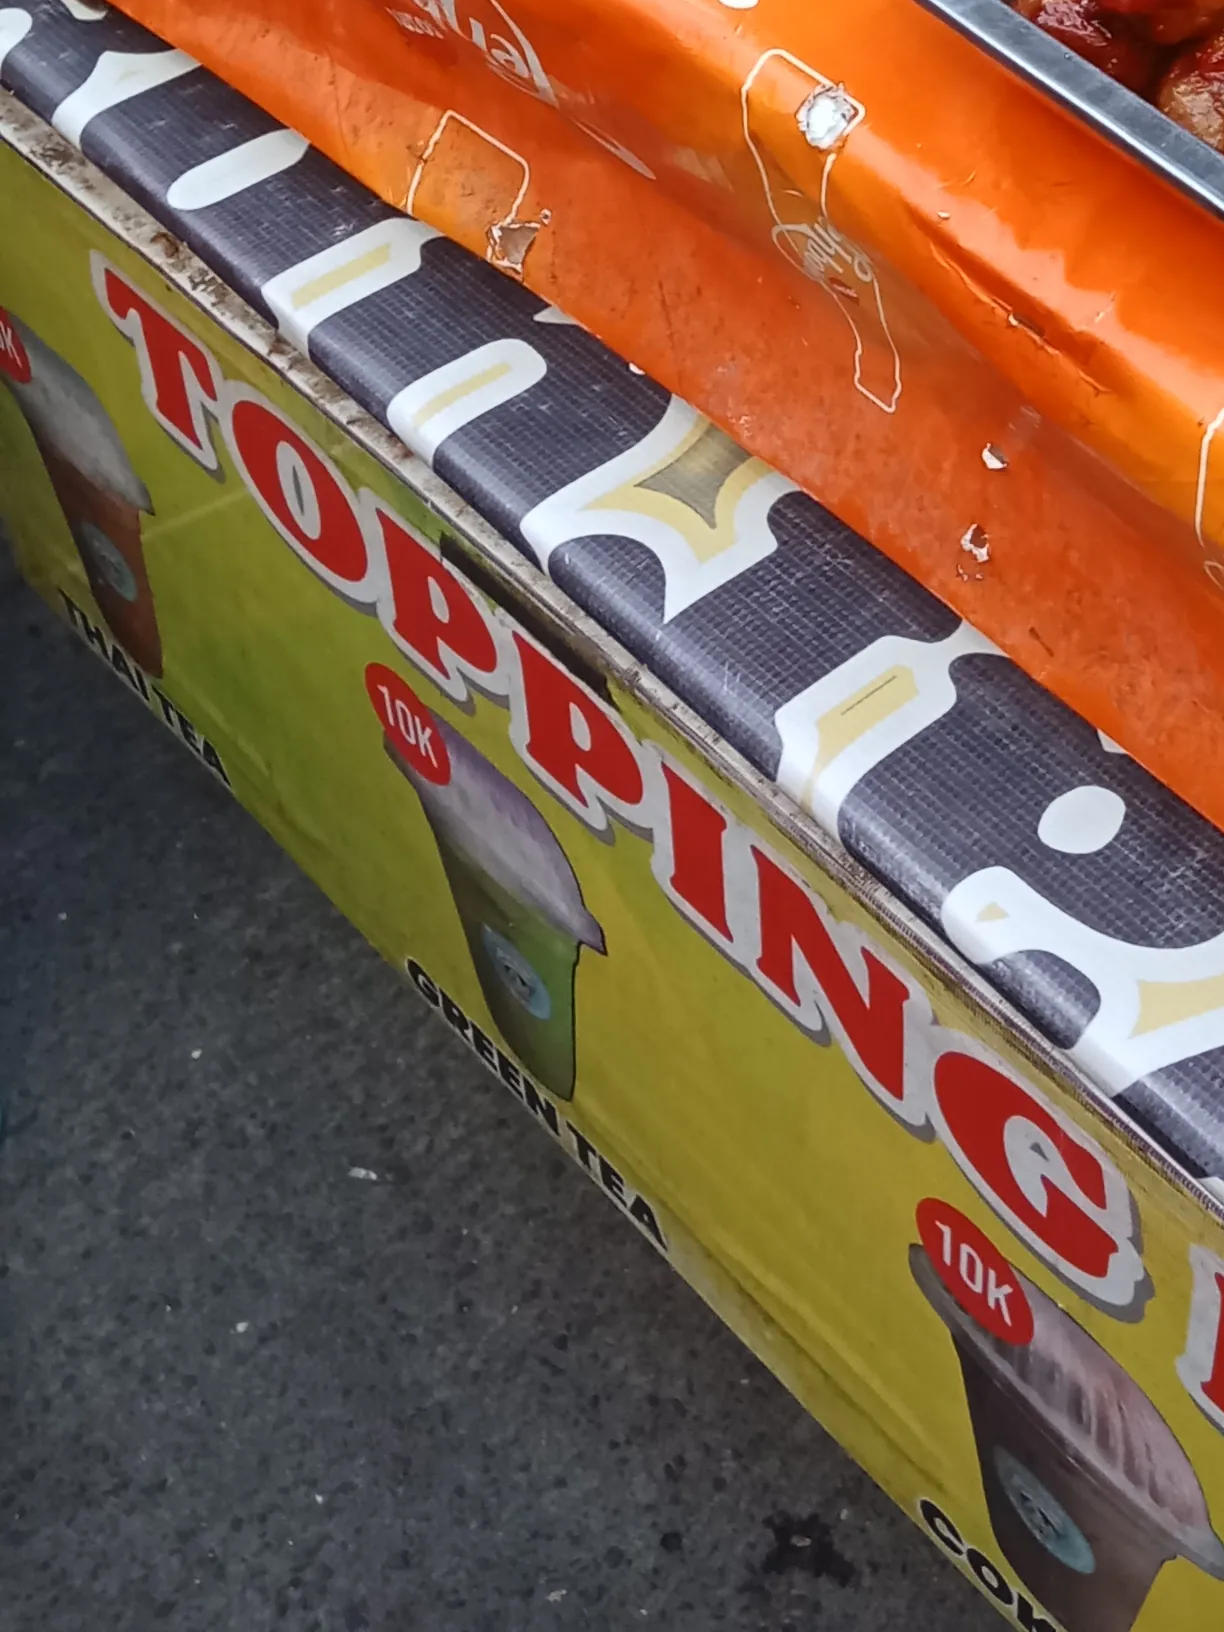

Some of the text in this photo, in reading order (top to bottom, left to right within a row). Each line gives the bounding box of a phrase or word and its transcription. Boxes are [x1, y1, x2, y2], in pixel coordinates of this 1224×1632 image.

[58, 587, 233, 788] THAI TEA
[93, 254, 1145, 1306] TOPPING
[377, 683, 440, 769] 10K
[406, 956, 669, 1252] GREEN TEA
[934, 1219, 1015, 1328] 10K
